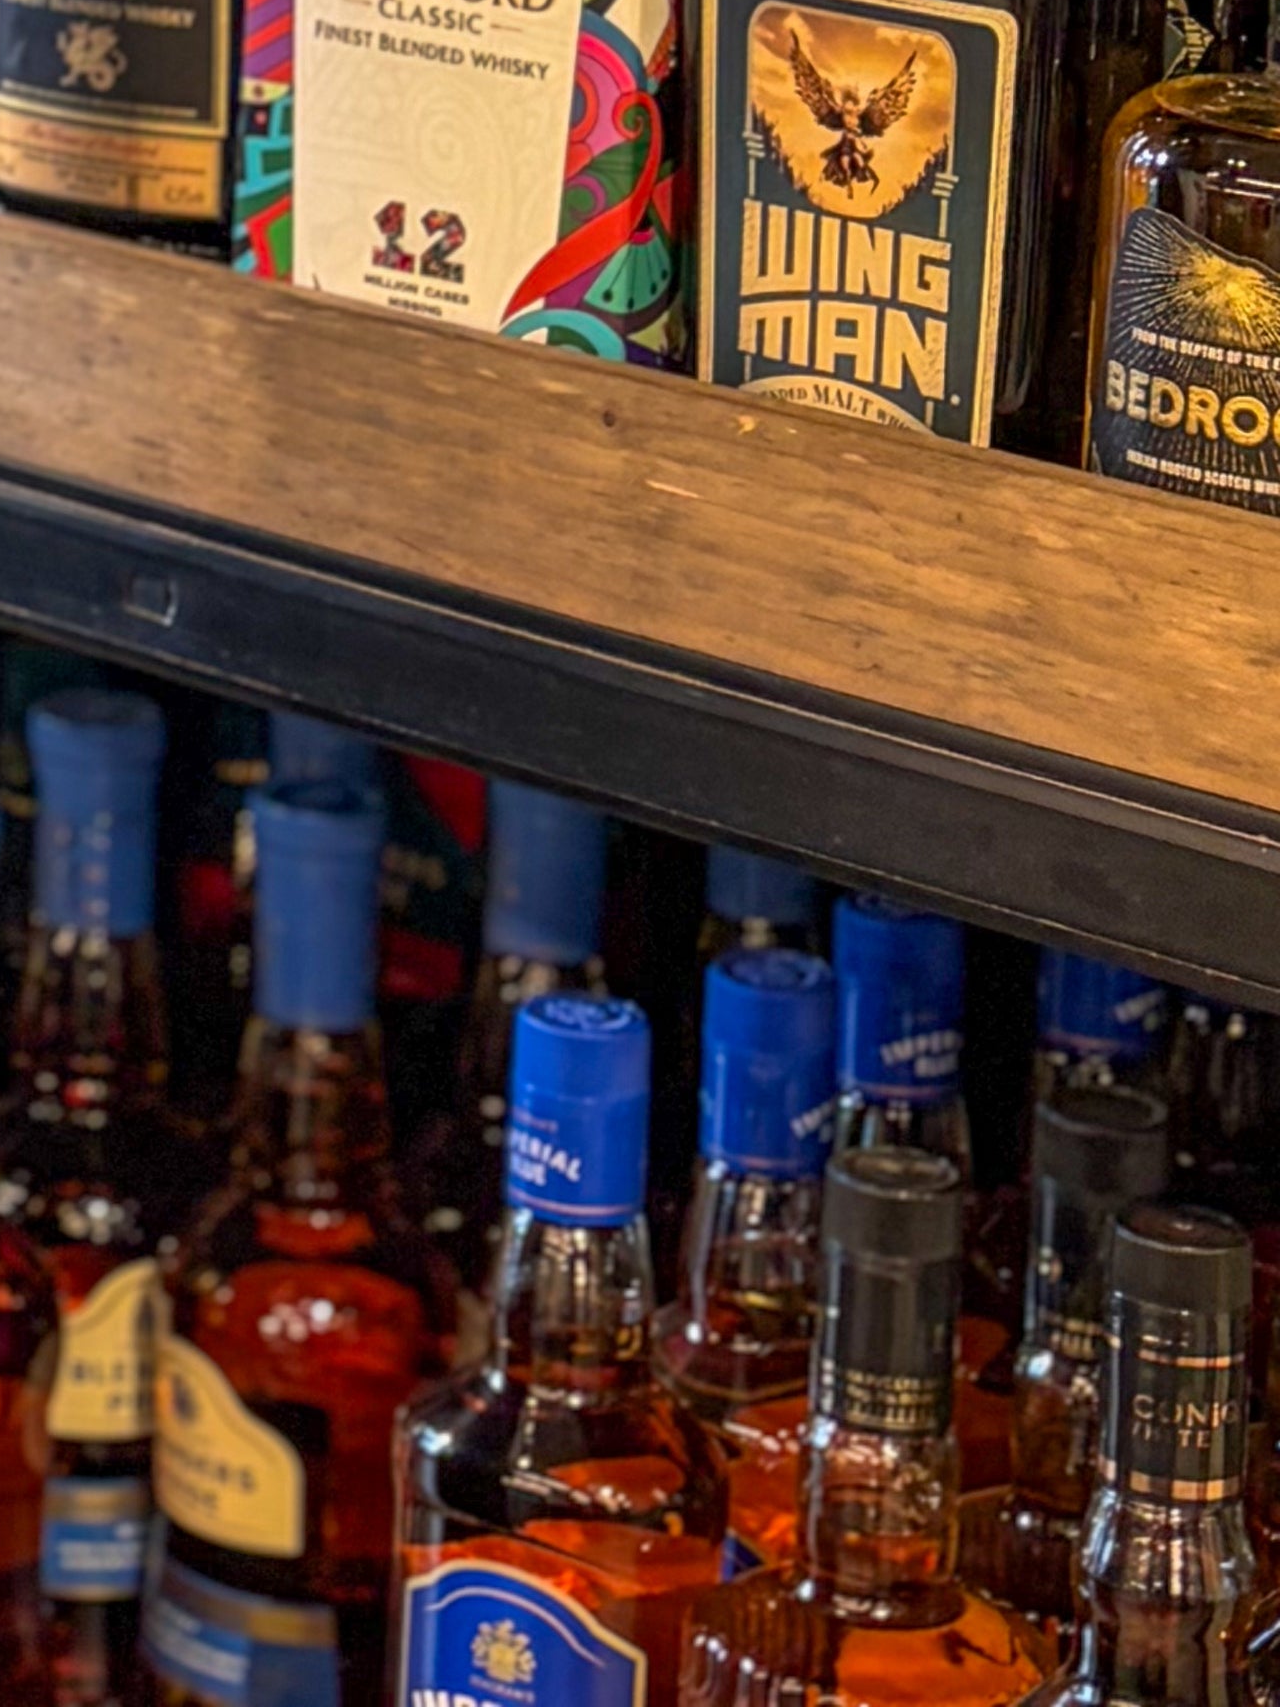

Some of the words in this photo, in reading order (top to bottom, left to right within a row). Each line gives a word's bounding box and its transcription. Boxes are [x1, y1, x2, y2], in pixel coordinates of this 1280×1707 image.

[124, 0, 198, 30] WHISKY
[314, 19, 373, 49] FINEST
[378, 33, 465, 65] BLENDED
[470, 49, 550, 81] WHISKY
[371, 199, 467, 285] 12
[740, 197, 952, 314] WING
[363, 273, 420, 294] MILLION
[737, 299, 949, 401] MAN
[811, 383, 874, 417] MALT
[1204, 470, 1252, 490] SCOTCH
